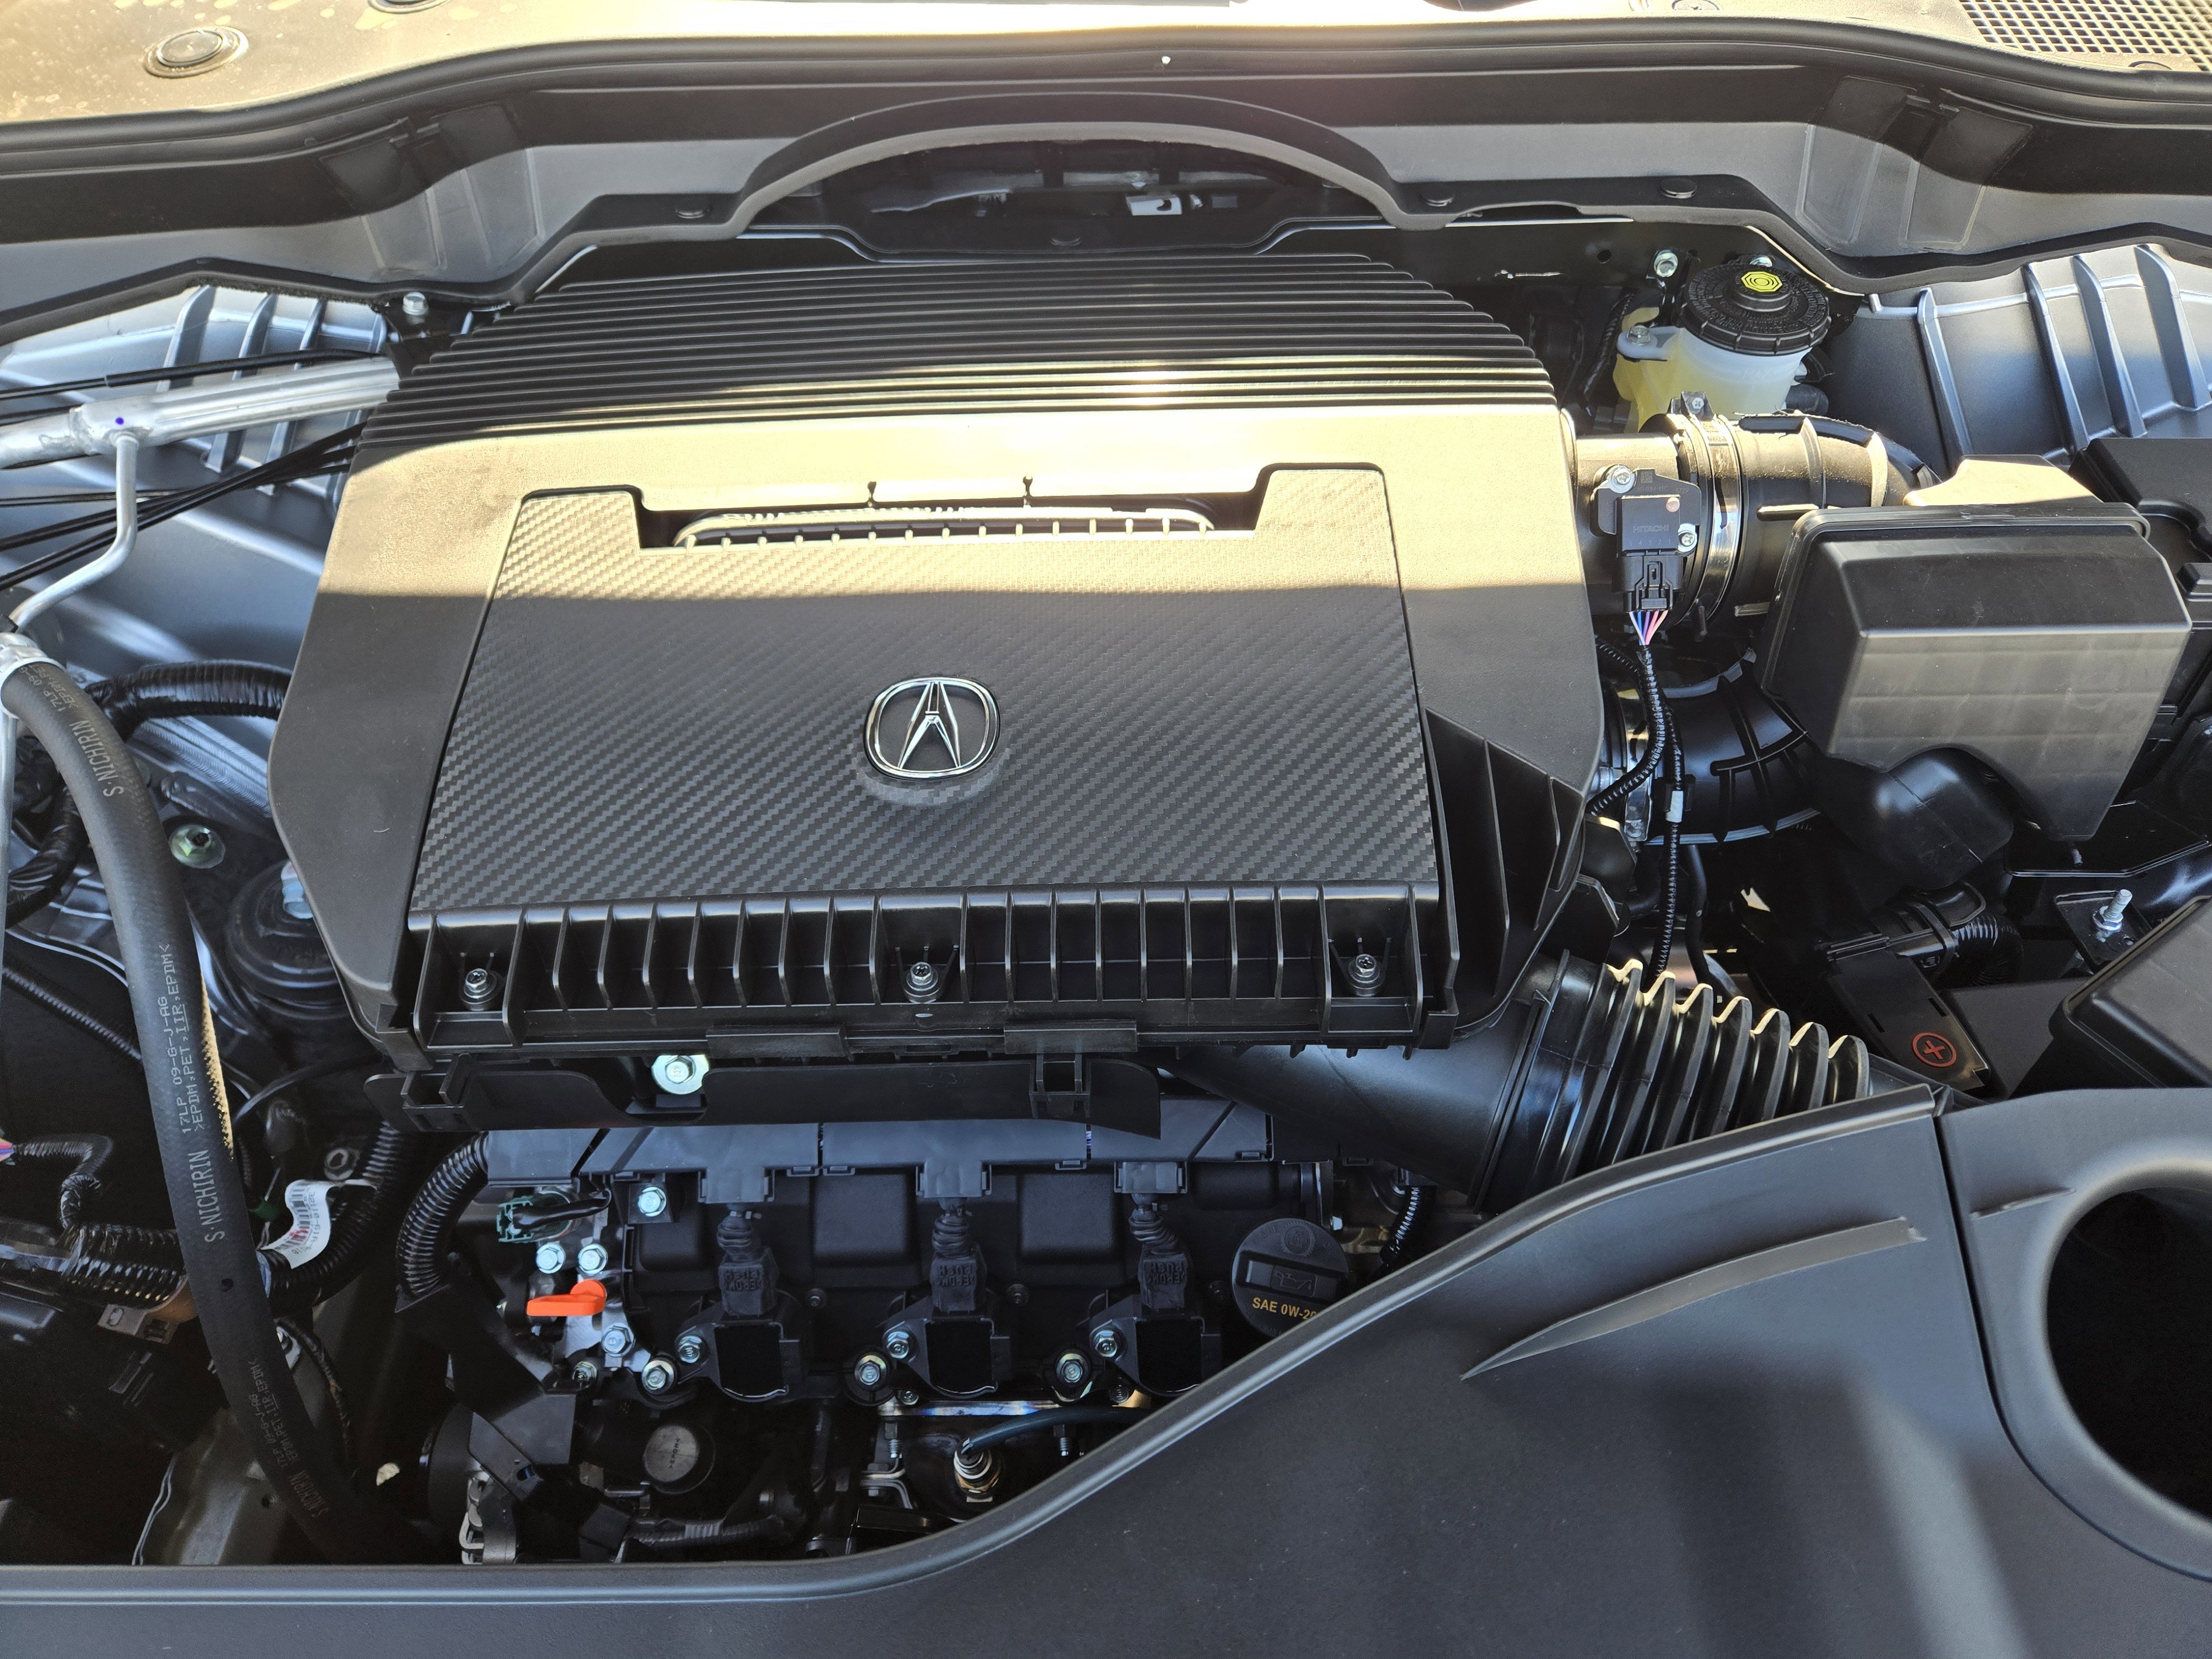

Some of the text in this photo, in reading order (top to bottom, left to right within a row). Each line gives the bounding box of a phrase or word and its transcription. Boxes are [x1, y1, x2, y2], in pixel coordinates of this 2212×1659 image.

[1632, 524, 1670, 533] HITACHI
[176, 1096, 192, 1134] 17LP
[1252, 1297, 1278, 1313] SAE
